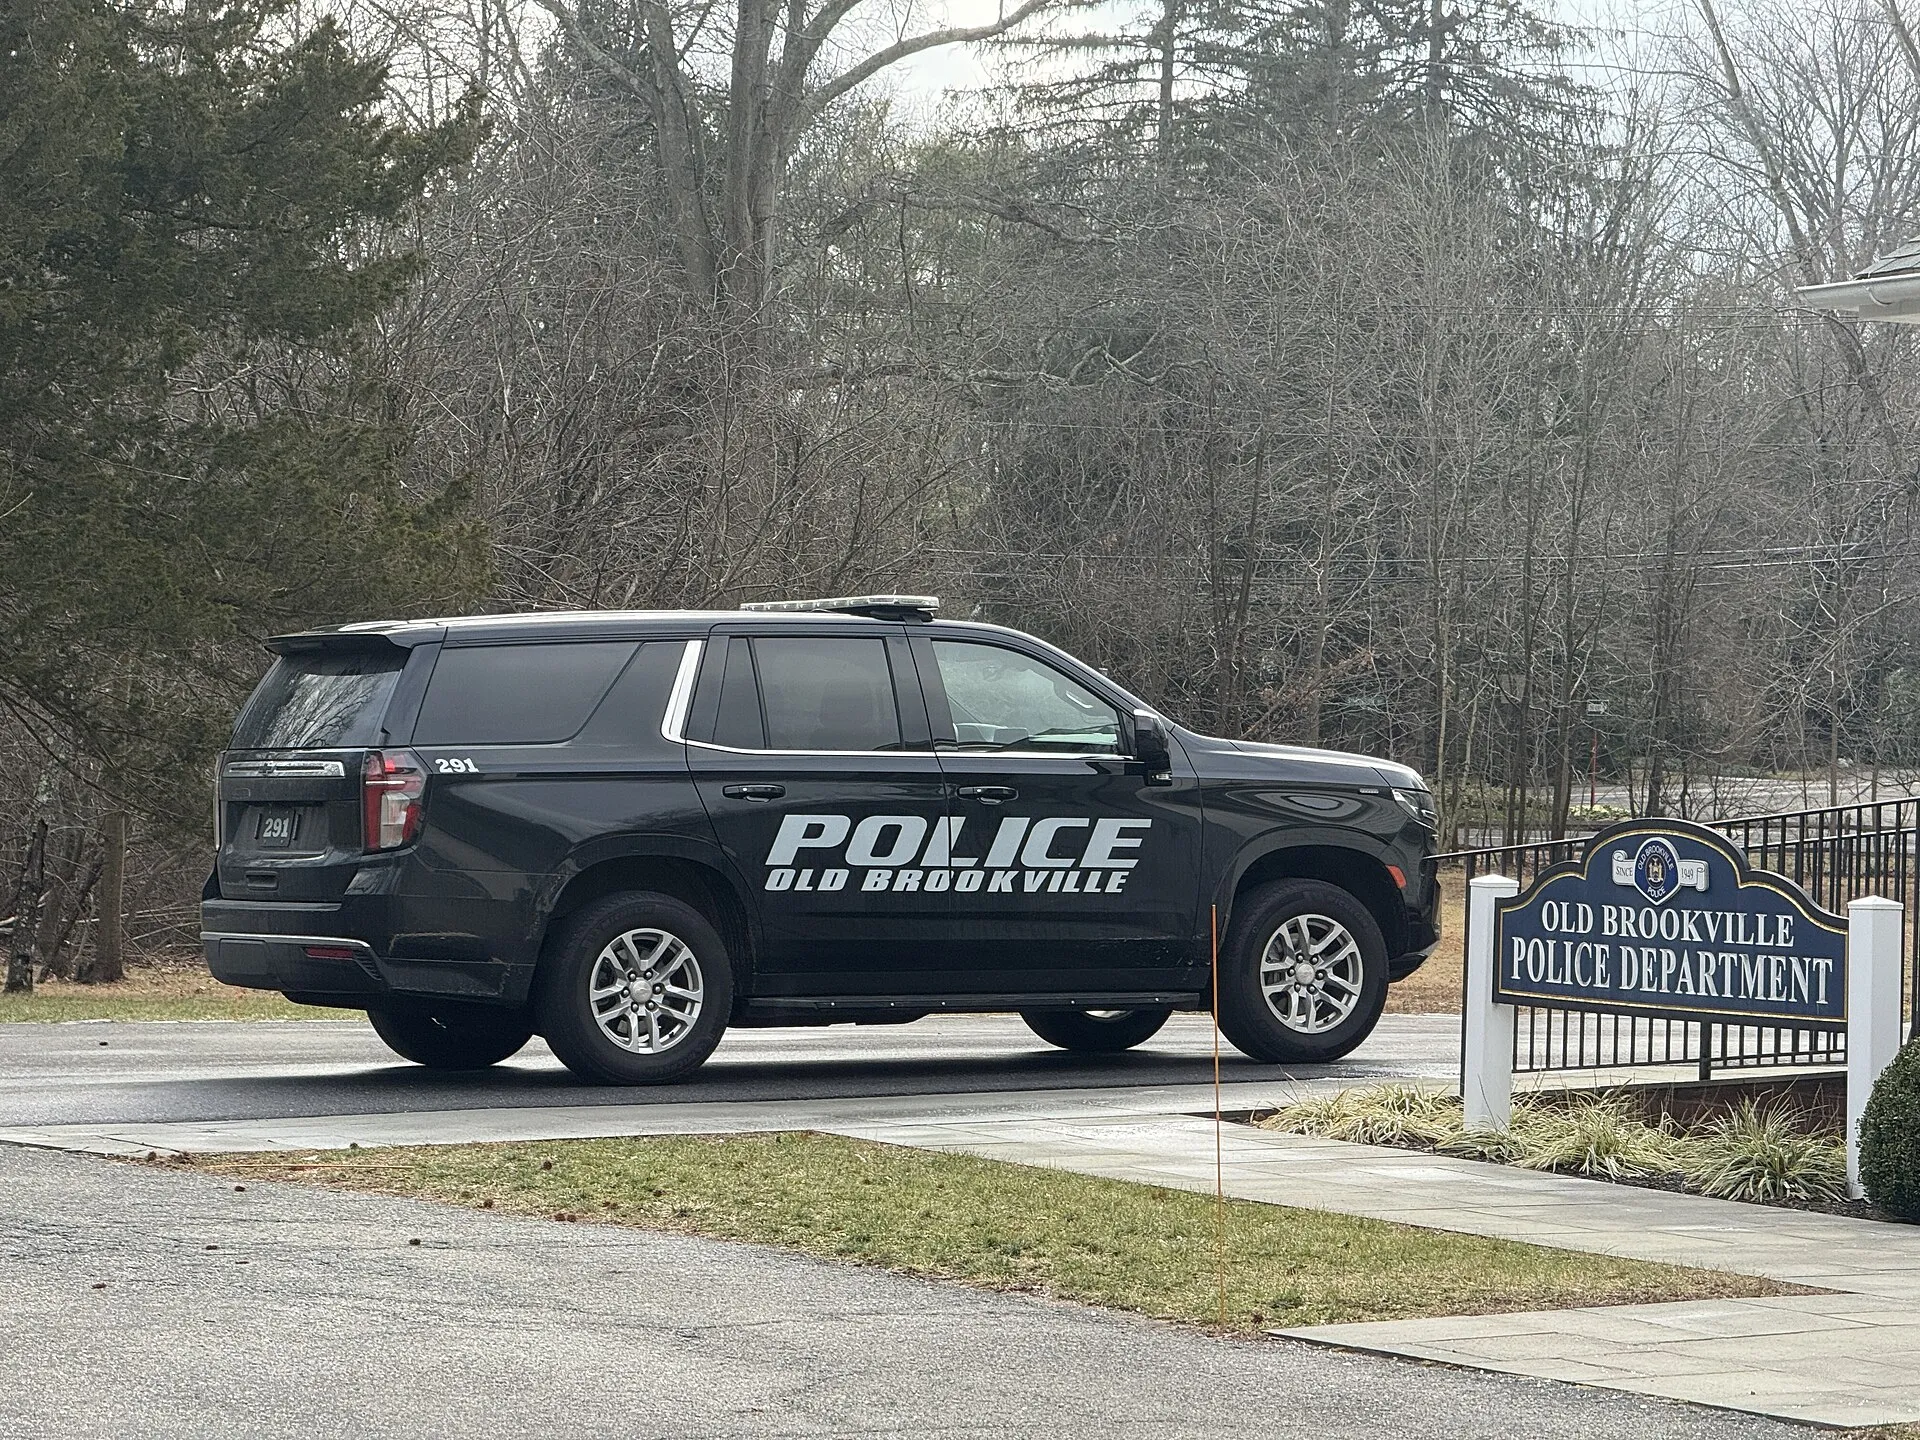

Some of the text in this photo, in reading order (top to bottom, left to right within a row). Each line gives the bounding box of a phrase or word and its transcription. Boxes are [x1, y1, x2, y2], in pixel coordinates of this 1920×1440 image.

[435, 758, 479, 773] 291
[263, 817, 290, 838] 291
[764, 814, 1152, 868] POLICE
[1638, 845, 1674, 870] OLD BROOKVILLE
[764, 868, 1130, 893] OLD BROOKVILLE
[1616, 866, 1633, 877] SINCE
[1681, 867, 1693, 879] 1949
[1647, 886, 1666, 898] POLICE
[1541, 900, 1795, 948] OLD BROOKVILLE
[1510, 936, 1833, 1005] POLICE DEPARTMENT
